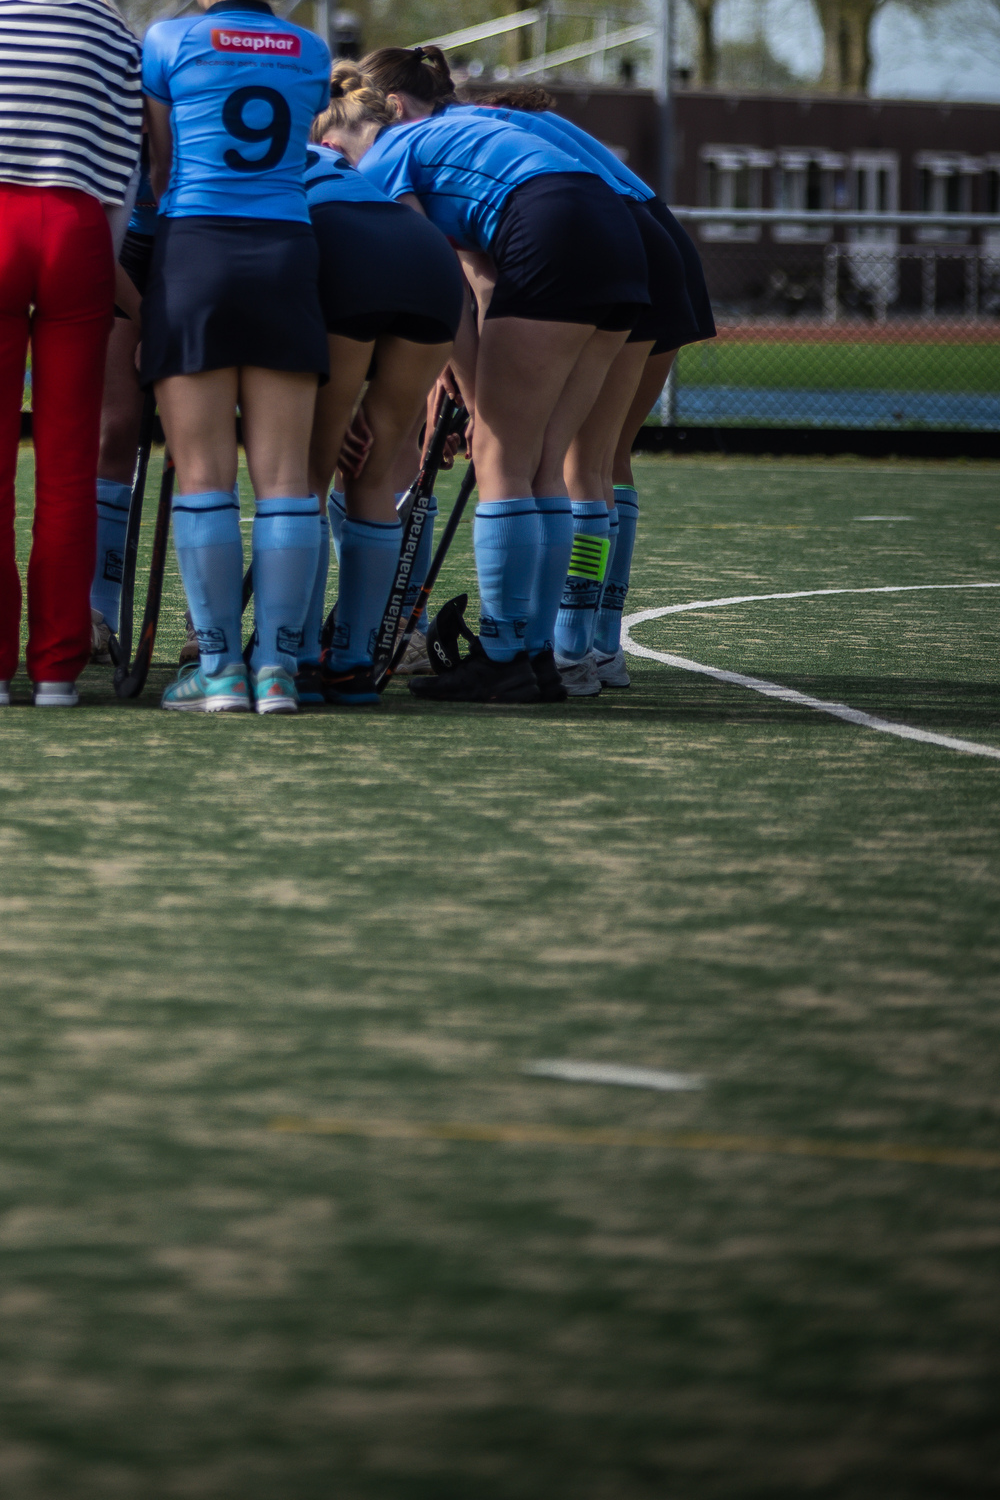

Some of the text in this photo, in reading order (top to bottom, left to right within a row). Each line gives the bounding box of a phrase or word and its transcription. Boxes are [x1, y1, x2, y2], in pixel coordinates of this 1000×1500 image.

[195, 59, 313, 76] Because pets are family too
[219, 32, 294, 51] beaphar
[222, 85, 292, 174] 9
[378, 594, 403, 649] indian
[395, 497, 430, 590] maharadja
